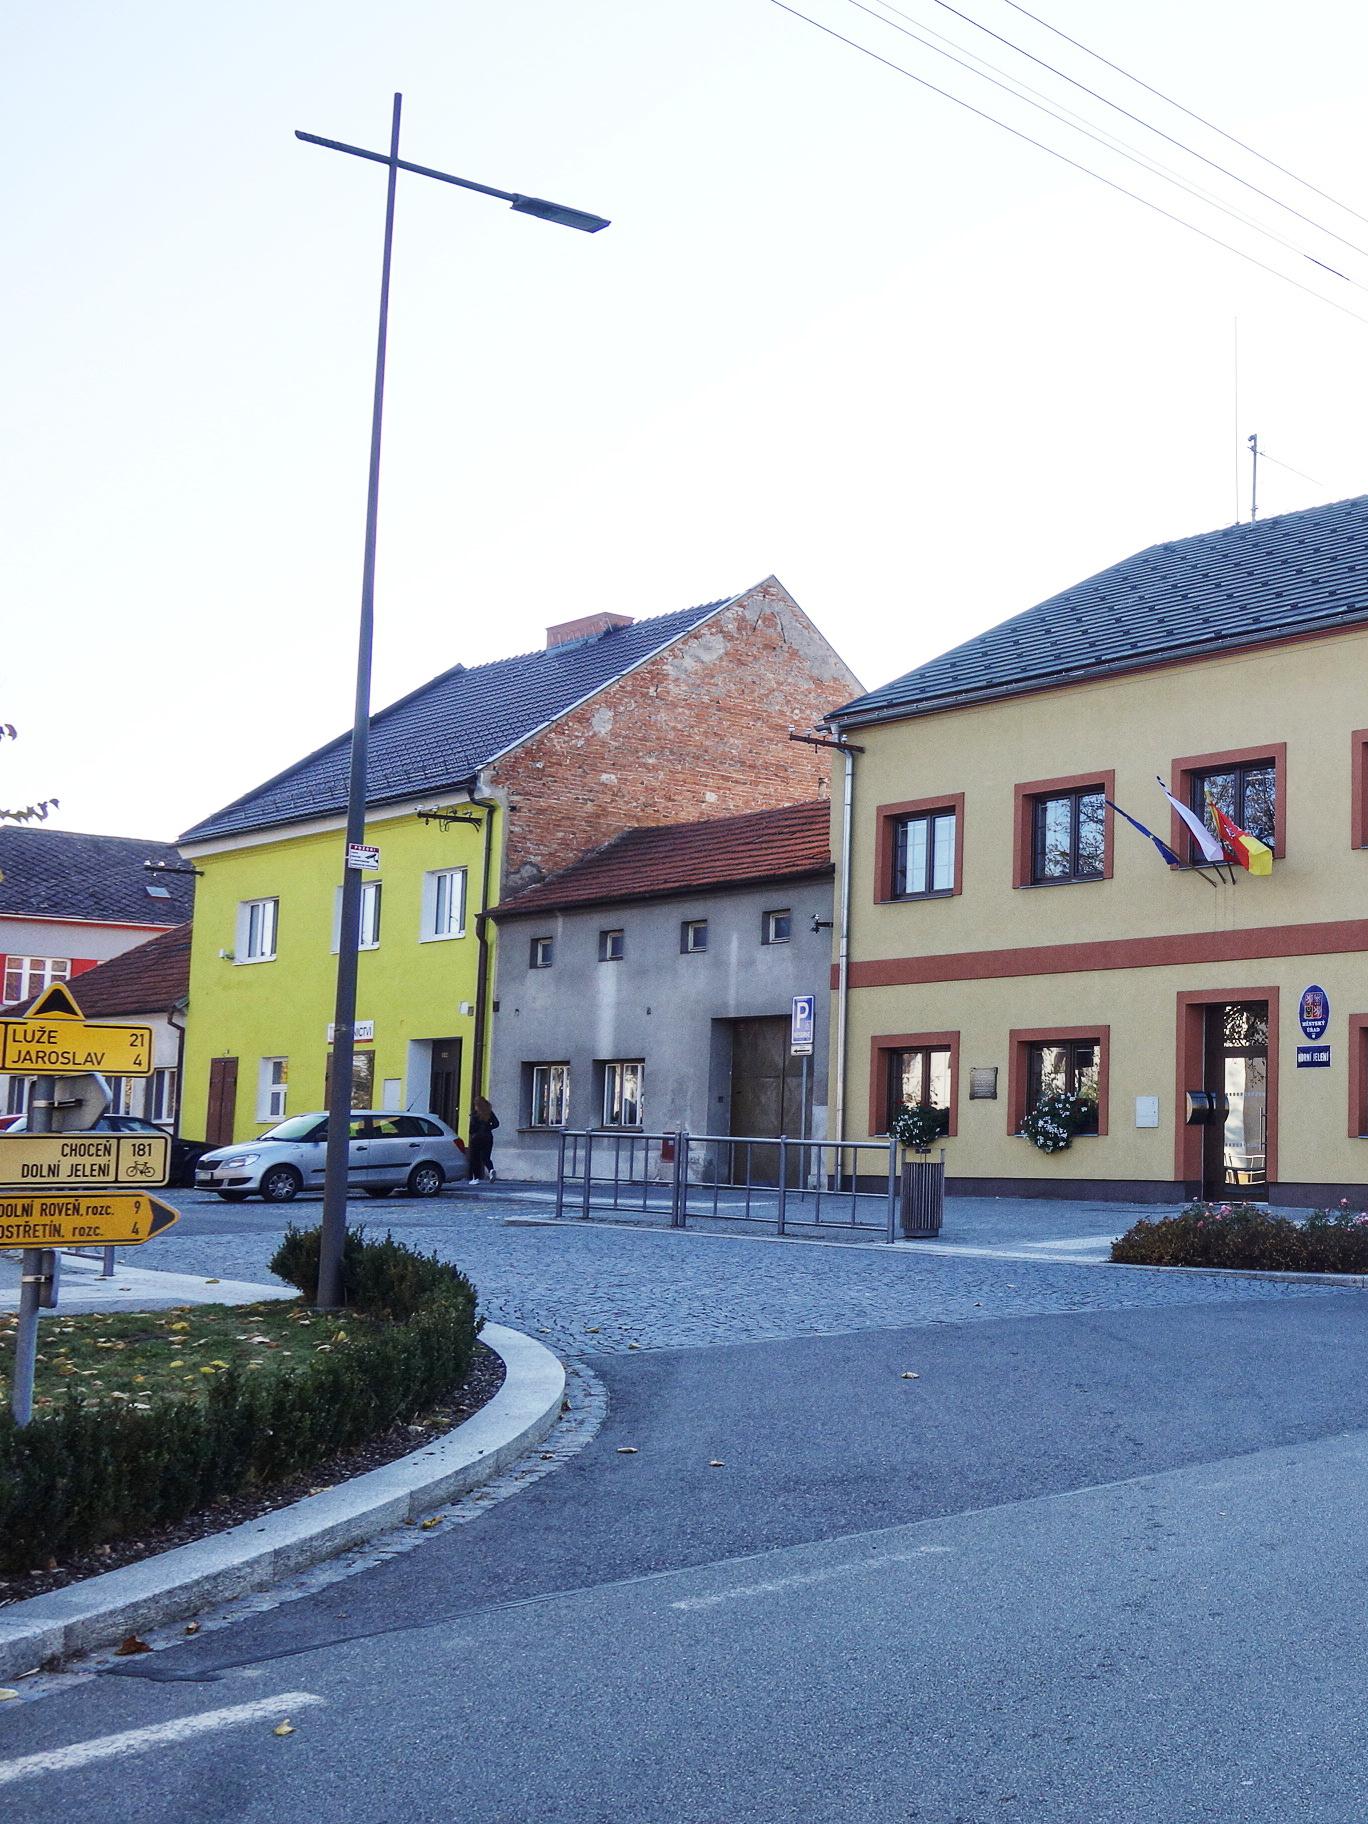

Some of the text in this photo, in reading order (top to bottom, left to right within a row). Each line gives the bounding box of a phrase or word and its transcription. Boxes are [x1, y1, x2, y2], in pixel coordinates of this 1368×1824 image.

[797, 1002, 809, 1028] P
[12, 1026, 145, 1047] LUŽE 21
[11, 1049, 142, 1067] JAROSLAV 4
[61, 1140, 153, 1157] CHOCEŇ 181
[21, 1159, 111, 1178] DOLNÍ JELENÍ
[134, 1200, 141, 1215] 9
[71, 1224, 104, 1237] rozc.
[131, 1221, 140, 1236] 4
